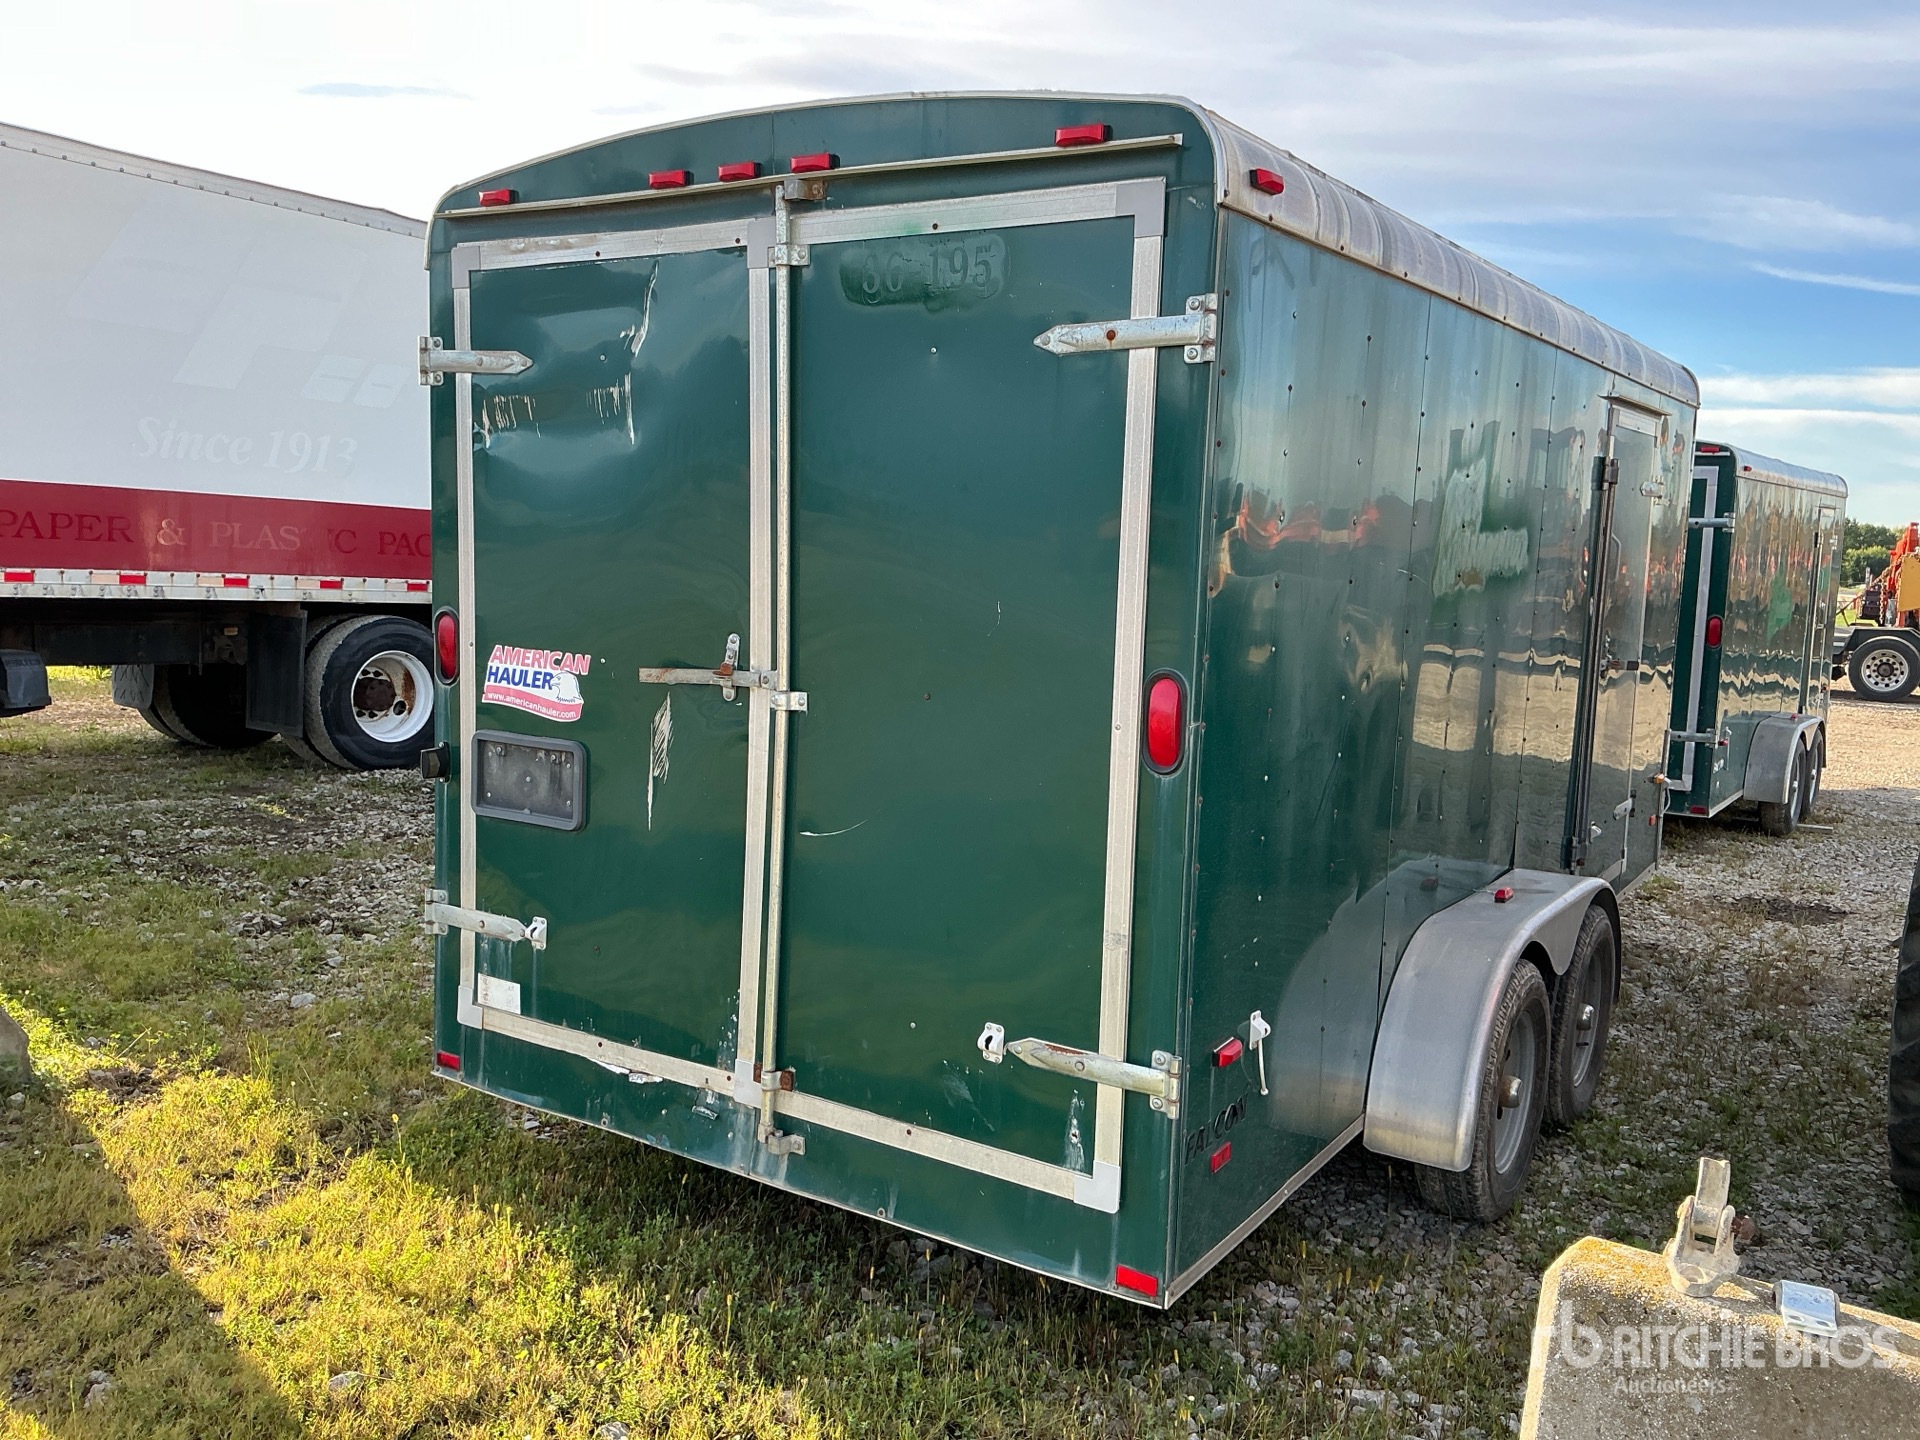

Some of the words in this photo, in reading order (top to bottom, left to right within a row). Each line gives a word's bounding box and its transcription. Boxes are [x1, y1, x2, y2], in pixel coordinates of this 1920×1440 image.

[136, 416, 253, 465] Since
[263, 430, 358, 475] 1913
[0, 509, 134, 543] PAPER
[156, 518, 187, 546] &
[490, 646, 590, 674] AMERICAN
[487, 665, 554, 690] HAULER
[487, 692, 577, 719] www.americanhauler.com
